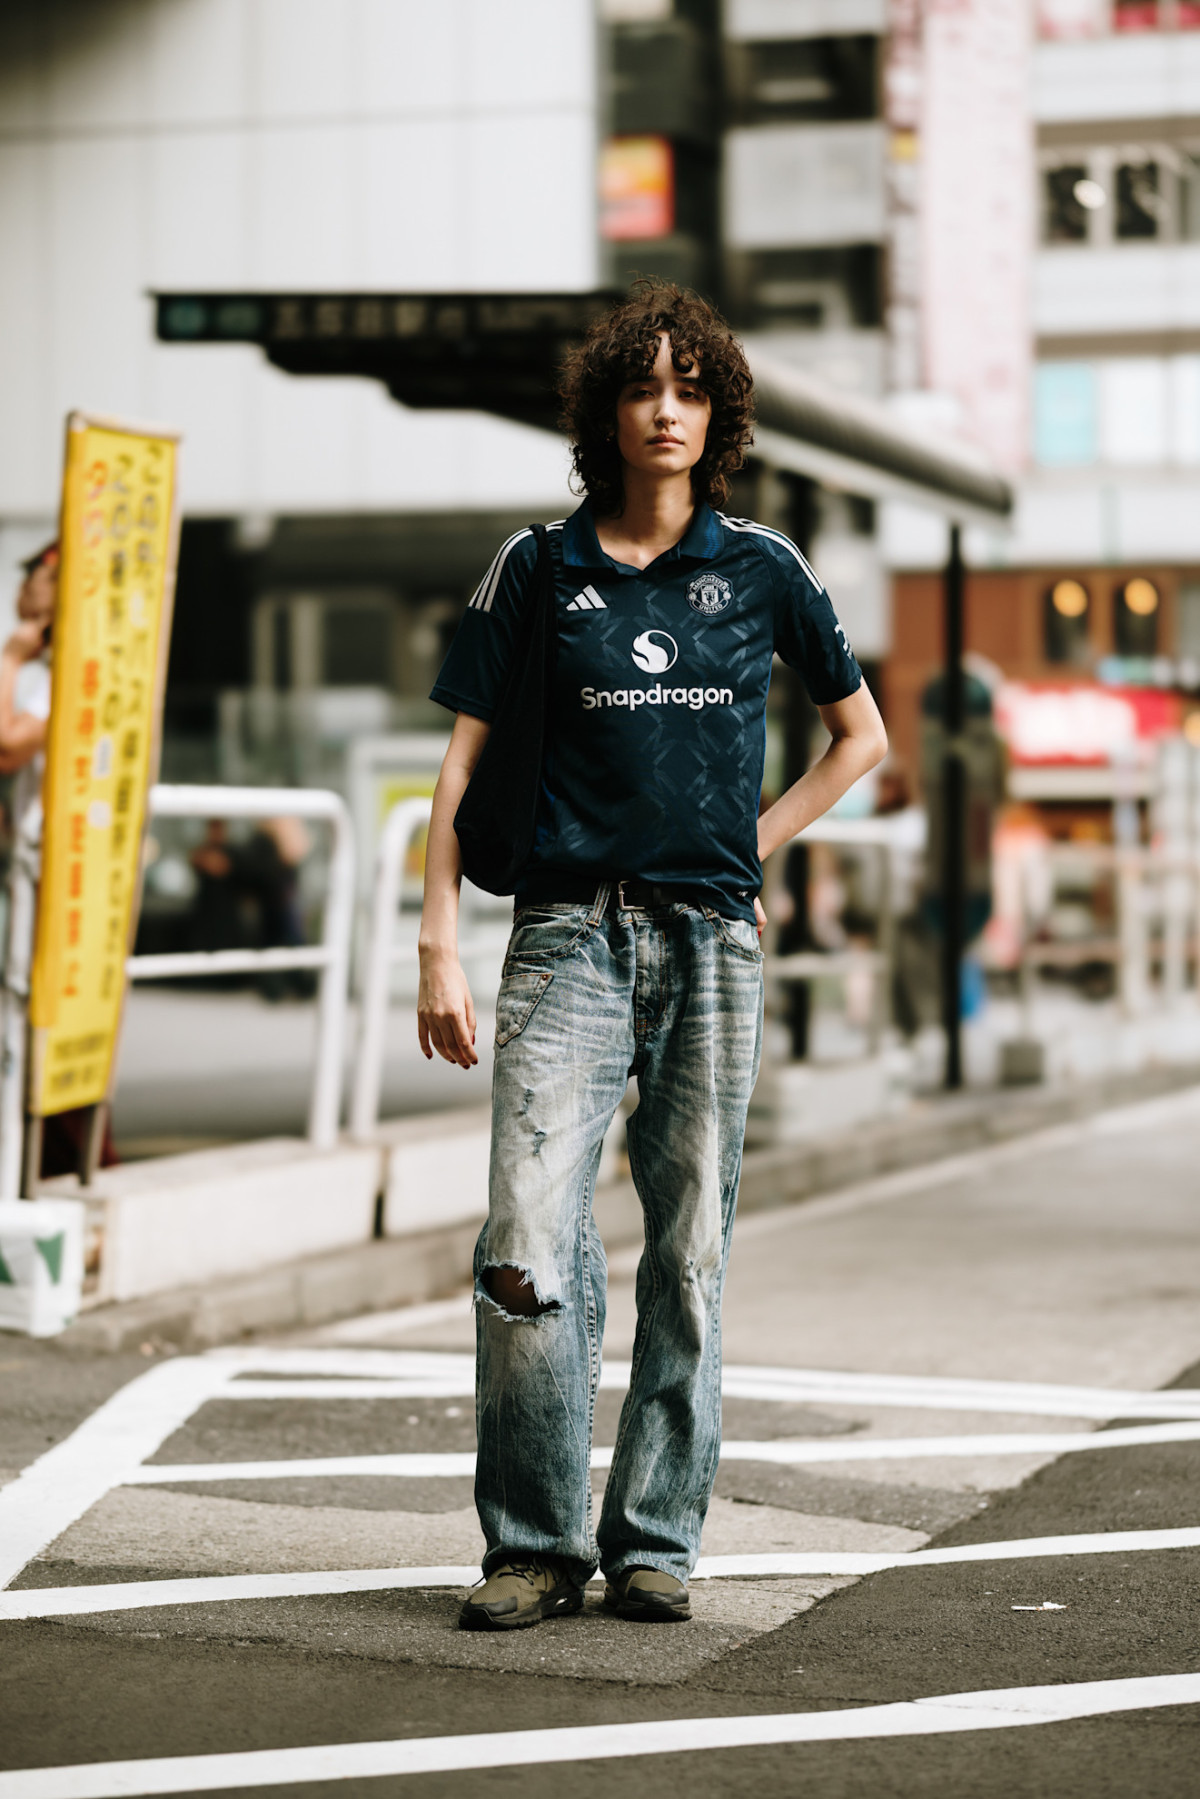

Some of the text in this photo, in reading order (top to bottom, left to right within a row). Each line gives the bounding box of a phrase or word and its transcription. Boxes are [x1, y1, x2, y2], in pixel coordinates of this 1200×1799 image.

[692, 577, 727, 590] MANCHESTER
[699, 603, 723, 611] UNITED
[580, 683, 733, 711] Snapdragon
